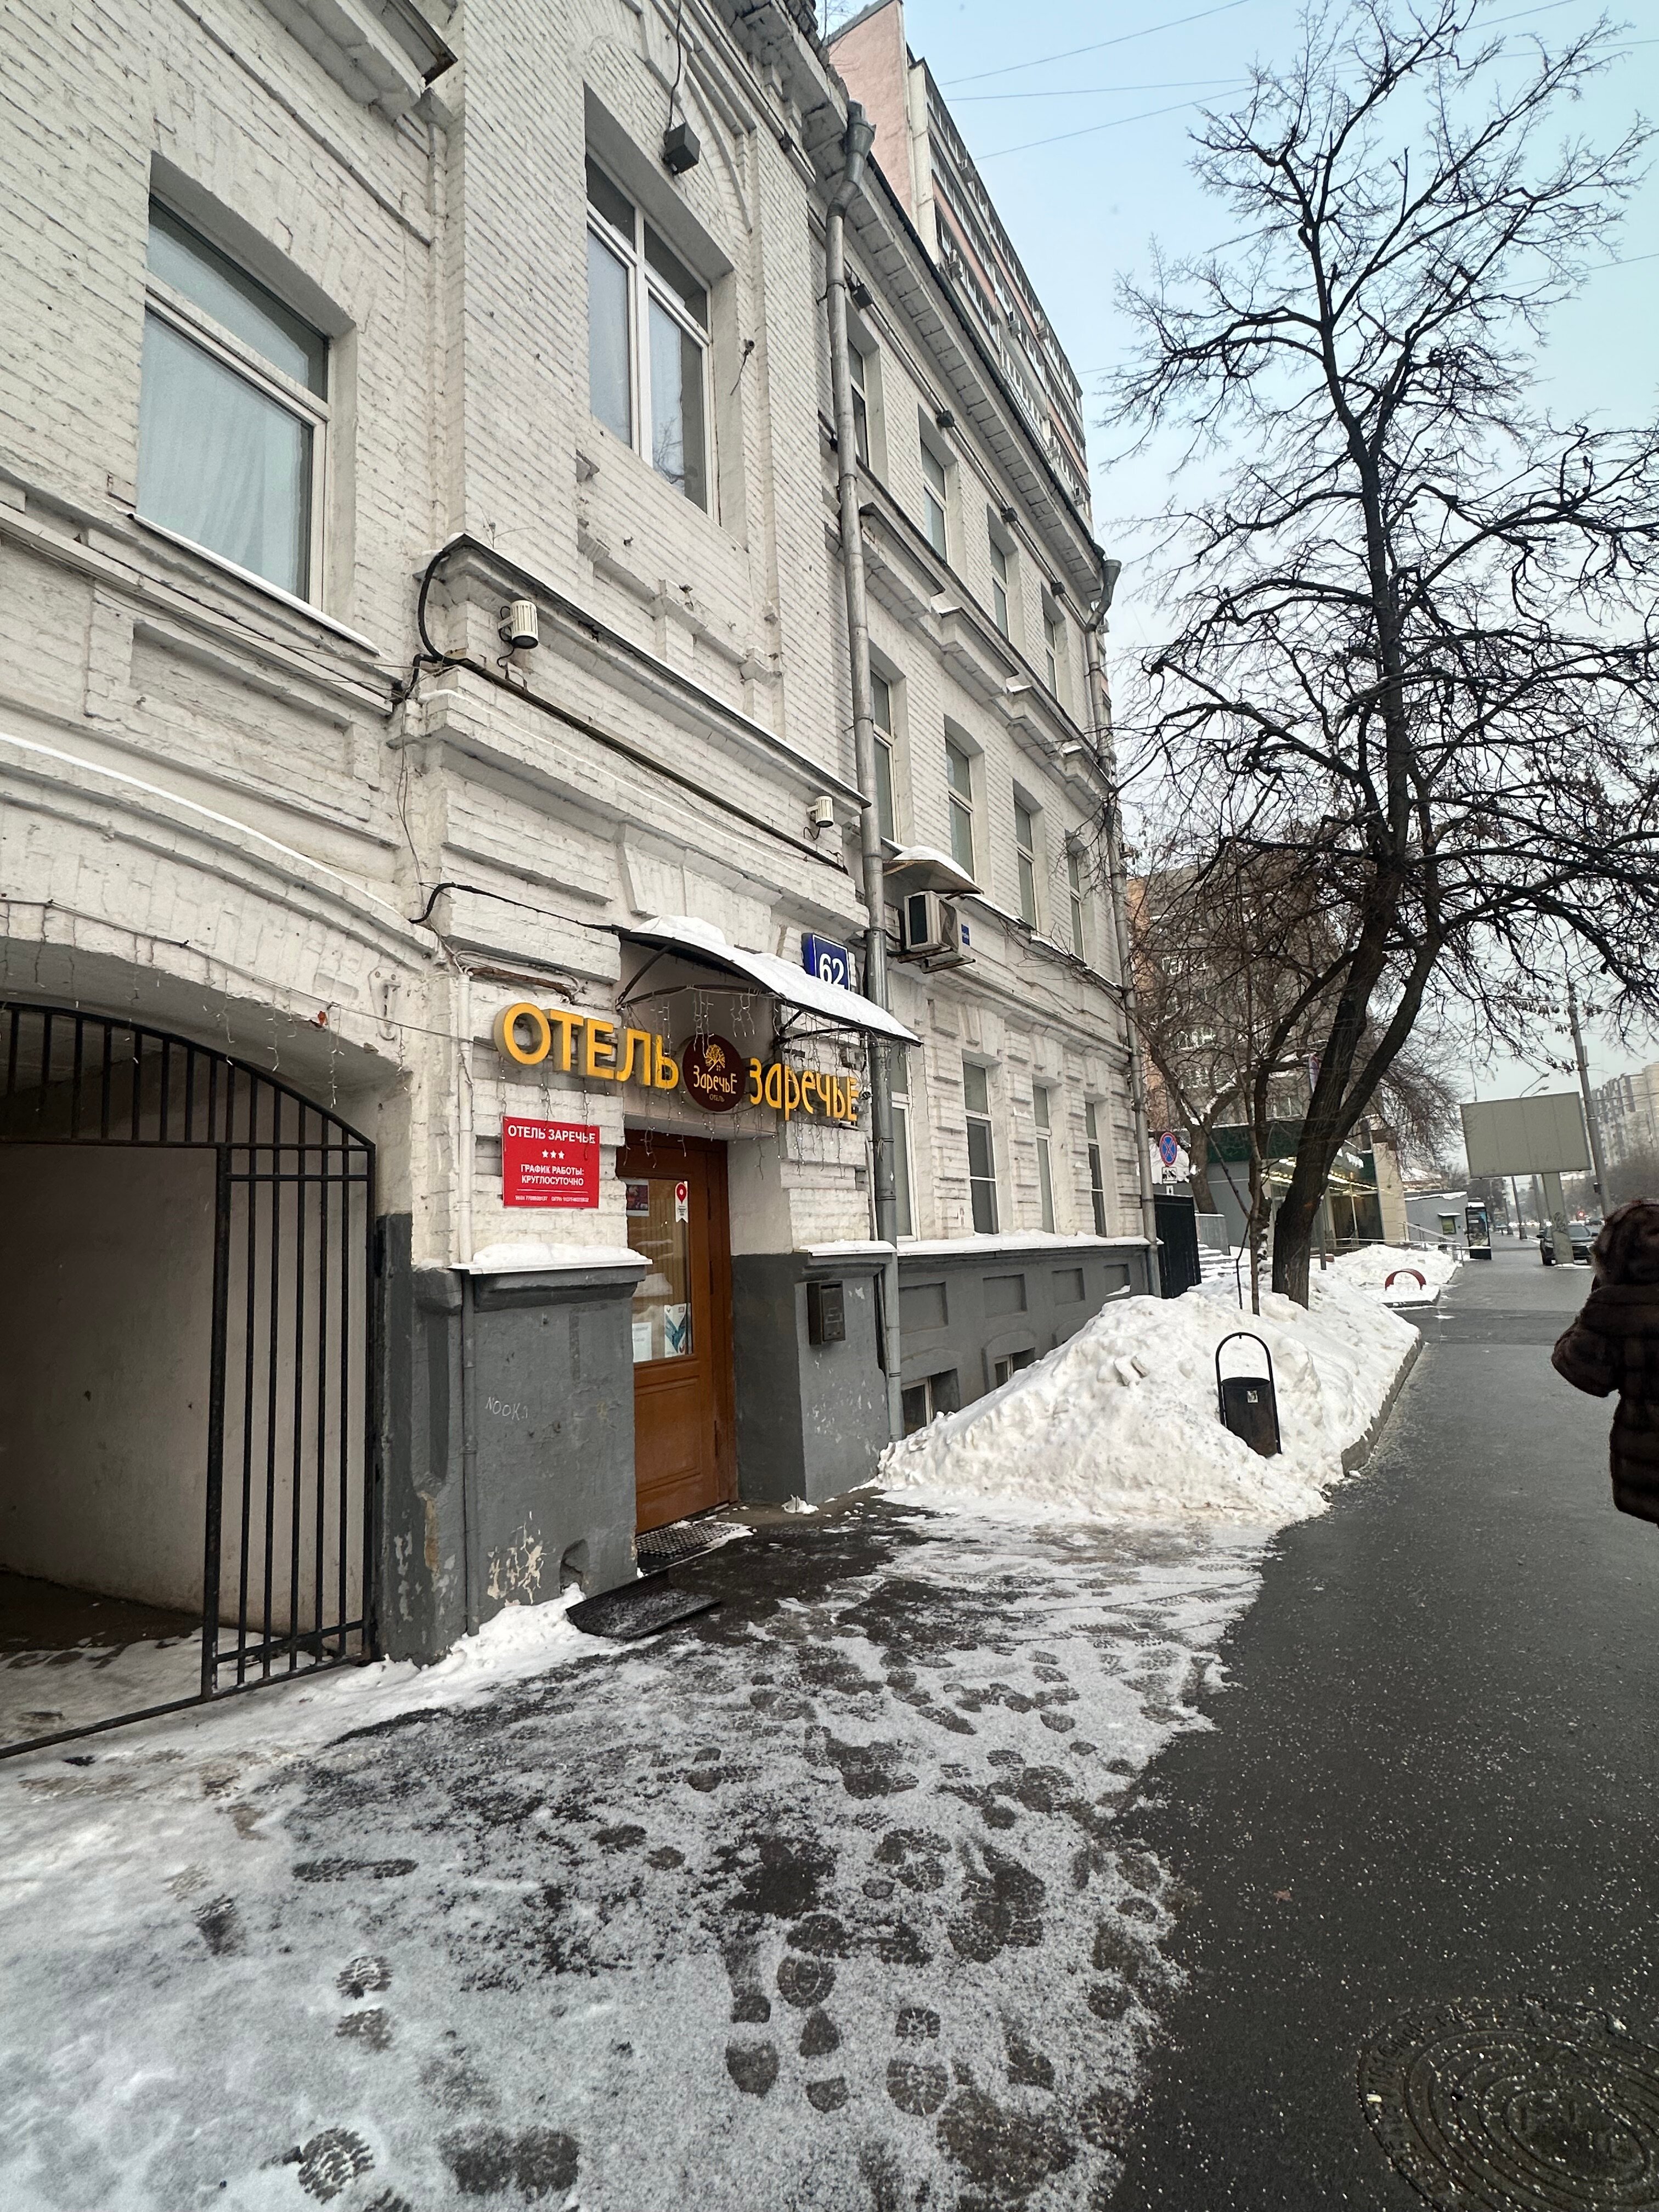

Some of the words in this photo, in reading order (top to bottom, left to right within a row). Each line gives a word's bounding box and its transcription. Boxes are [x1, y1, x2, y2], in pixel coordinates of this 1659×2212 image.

[820, 953, 845, 987] 62
[503, 1002, 679, 1090] ОТЕЛЬ
[507, 1125, 546, 1139] ОТЕЛЬ
[548, 1128, 596, 1144] ЗАРЕЧЬЕ
[521, 1164, 551, 1175] ГРАФИК
[552, 1165, 585, 1176] РАБОТЫ:
[521, 1175, 584, 1186] КРУГЛОСУТОЧНО
